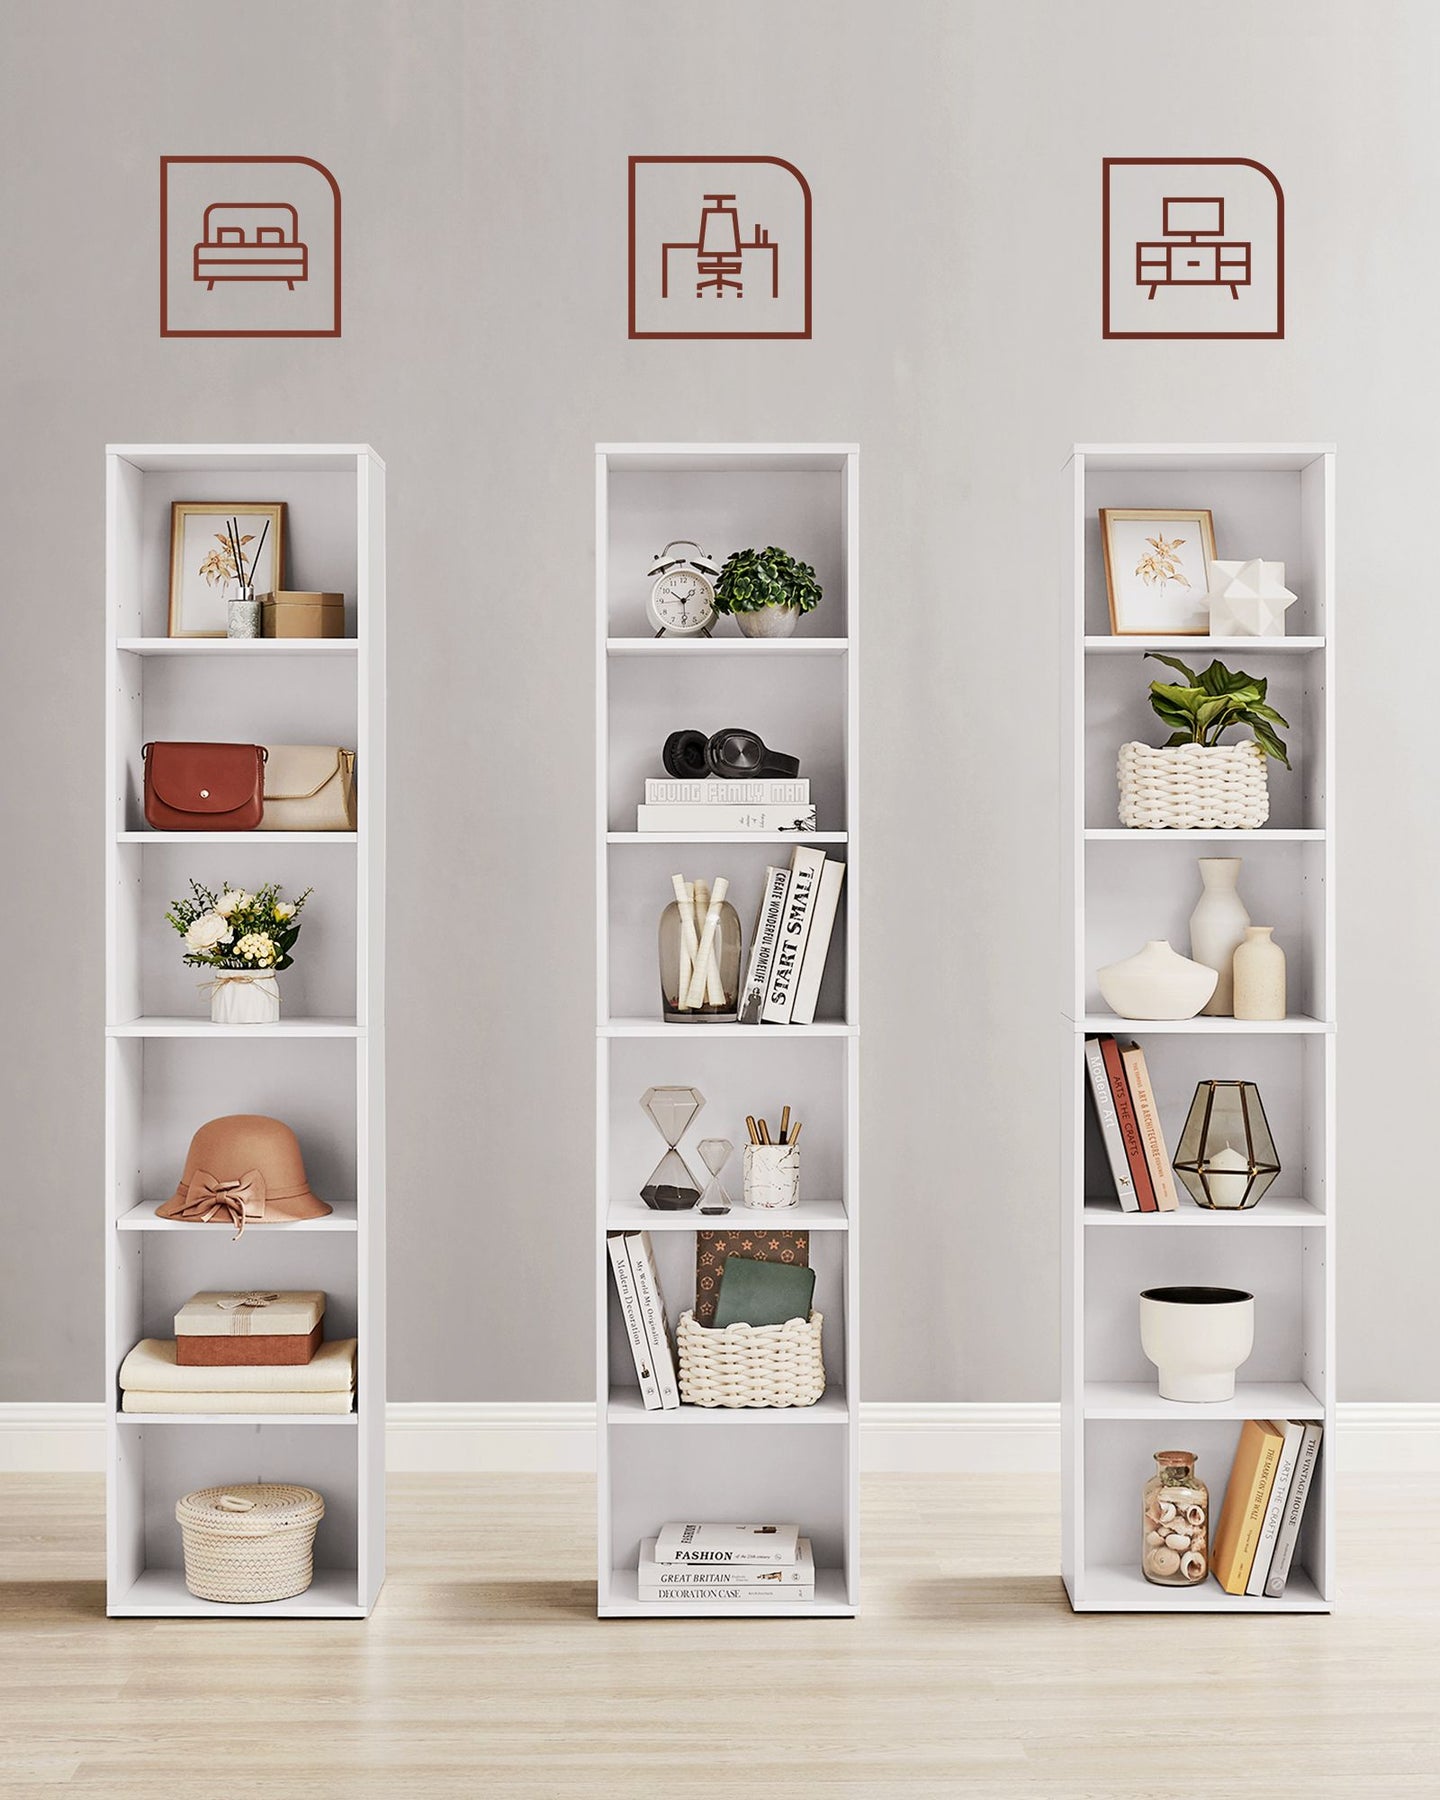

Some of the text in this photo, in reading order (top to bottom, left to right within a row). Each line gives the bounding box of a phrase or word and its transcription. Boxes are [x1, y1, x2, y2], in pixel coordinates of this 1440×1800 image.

[651, 784, 805, 802] LOVING FAMILY MAN
[754, 872, 786, 984] CREATE WONDERFUL HOMELIFE
[772, 867, 814, 1006] START SMALL
[1090, 1056, 1115, 1128] Modern Art
[1114, 1076, 1139, 1156] ARTS THE CRAFTS
[1138, 1090, 1146, 1104] ART
[1142, 1108, 1160, 1157] ARCHITECTURE
[617, 1259, 640, 1346] Modern Decoration
[636, 1261, 660, 1346] My World My Originality
[1259, 1481, 1267, 1490] ON
[1266, 1448, 1275, 1460] THE
[1289, 1439, 1316, 1526] THE VINTAGE HOUSE
[1250, 1504, 1262, 1520] WALL
[1255, 1490, 1265, 1504] THE
[1265, 1460, 1291, 1540] ARTS THE CRAFTS
[661, 1574, 694, 1582] GREAT
[693, 1574, 731, 1582] BRITAIN
[675, 1551, 733, 1560] FASHION
[658, 1590, 718, 1598] DECORATION
[718, 1590, 741, 1598] CASE
